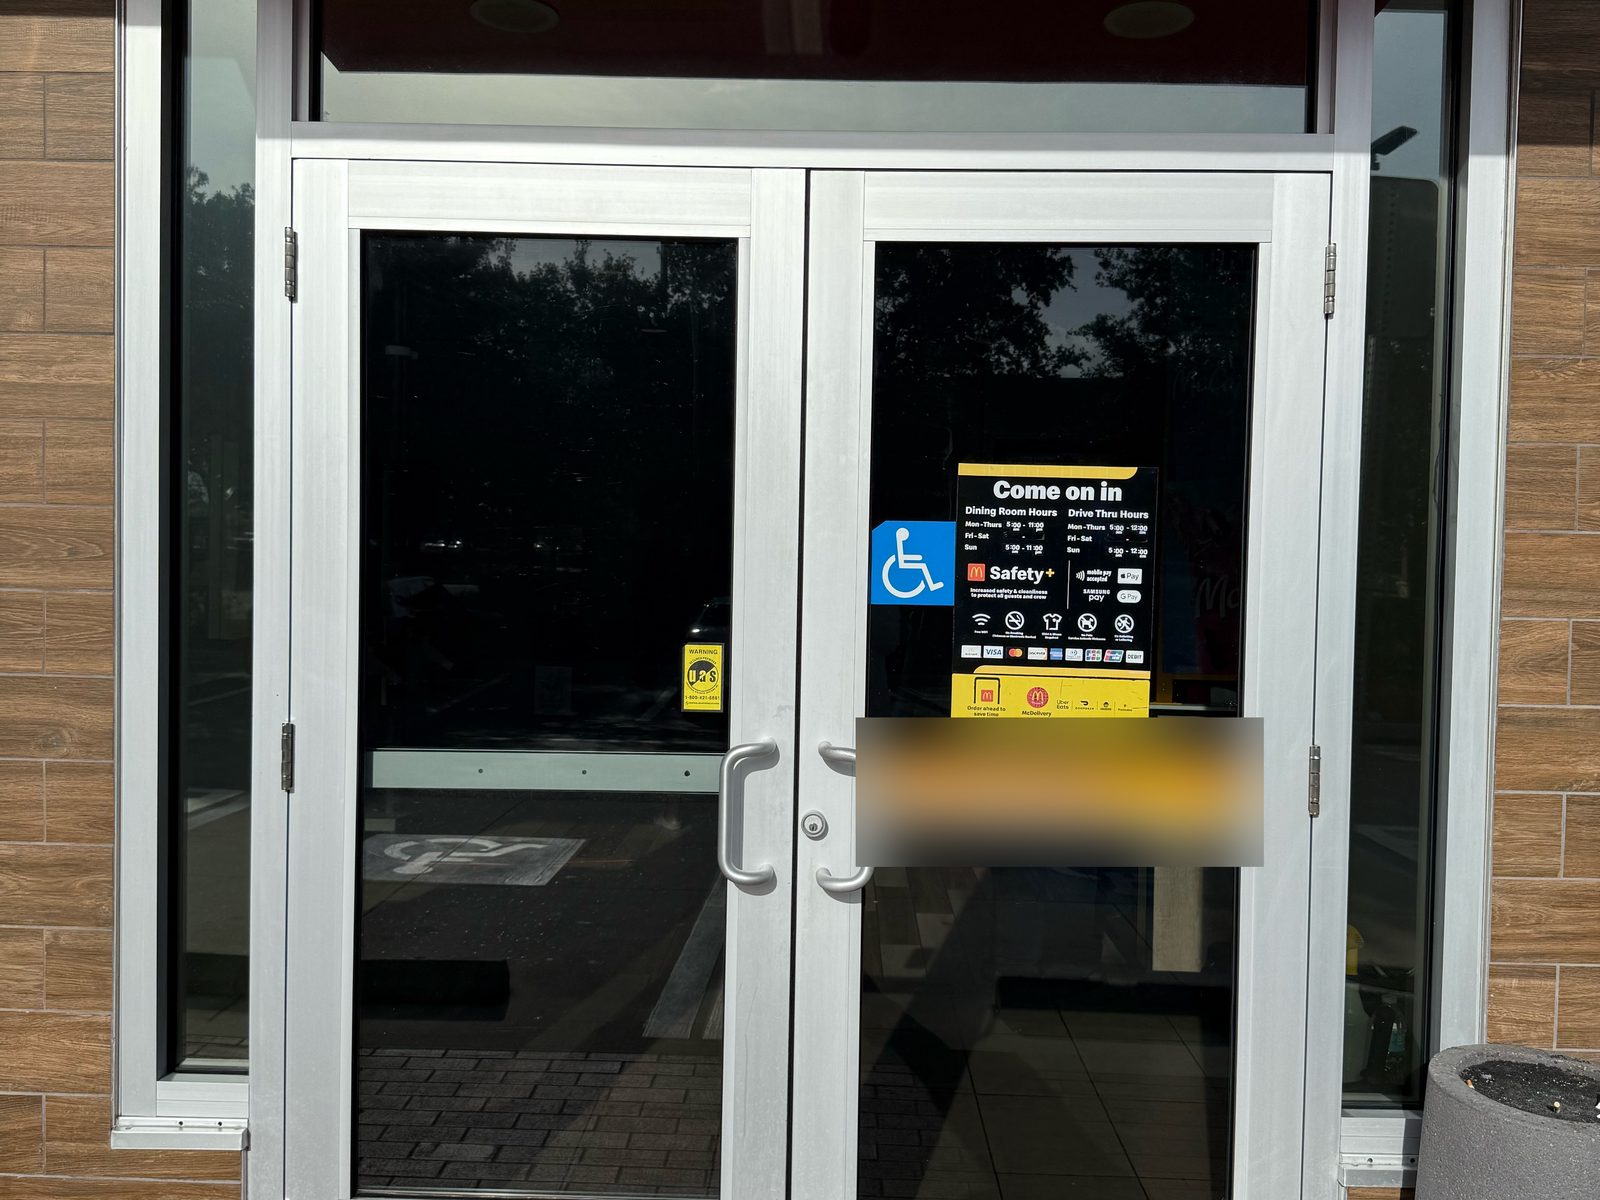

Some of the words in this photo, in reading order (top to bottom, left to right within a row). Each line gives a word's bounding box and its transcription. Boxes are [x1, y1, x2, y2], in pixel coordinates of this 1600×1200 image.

[993, 480, 1061, 500] Come
[1065, 486, 1095, 501] on
[1100, 481, 1122, 502] in
[965, 506, 996, 517] Dining
[998, 507, 1026, 516] Room
[1028, 507, 1058, 517] Hours
[1068, 508, 1094, 517] Drive
[1095, 509, 1118, 518] Thru
[1120, 510, 1149, 519] Hours
[1127, 572, 1140, 581] Pay
